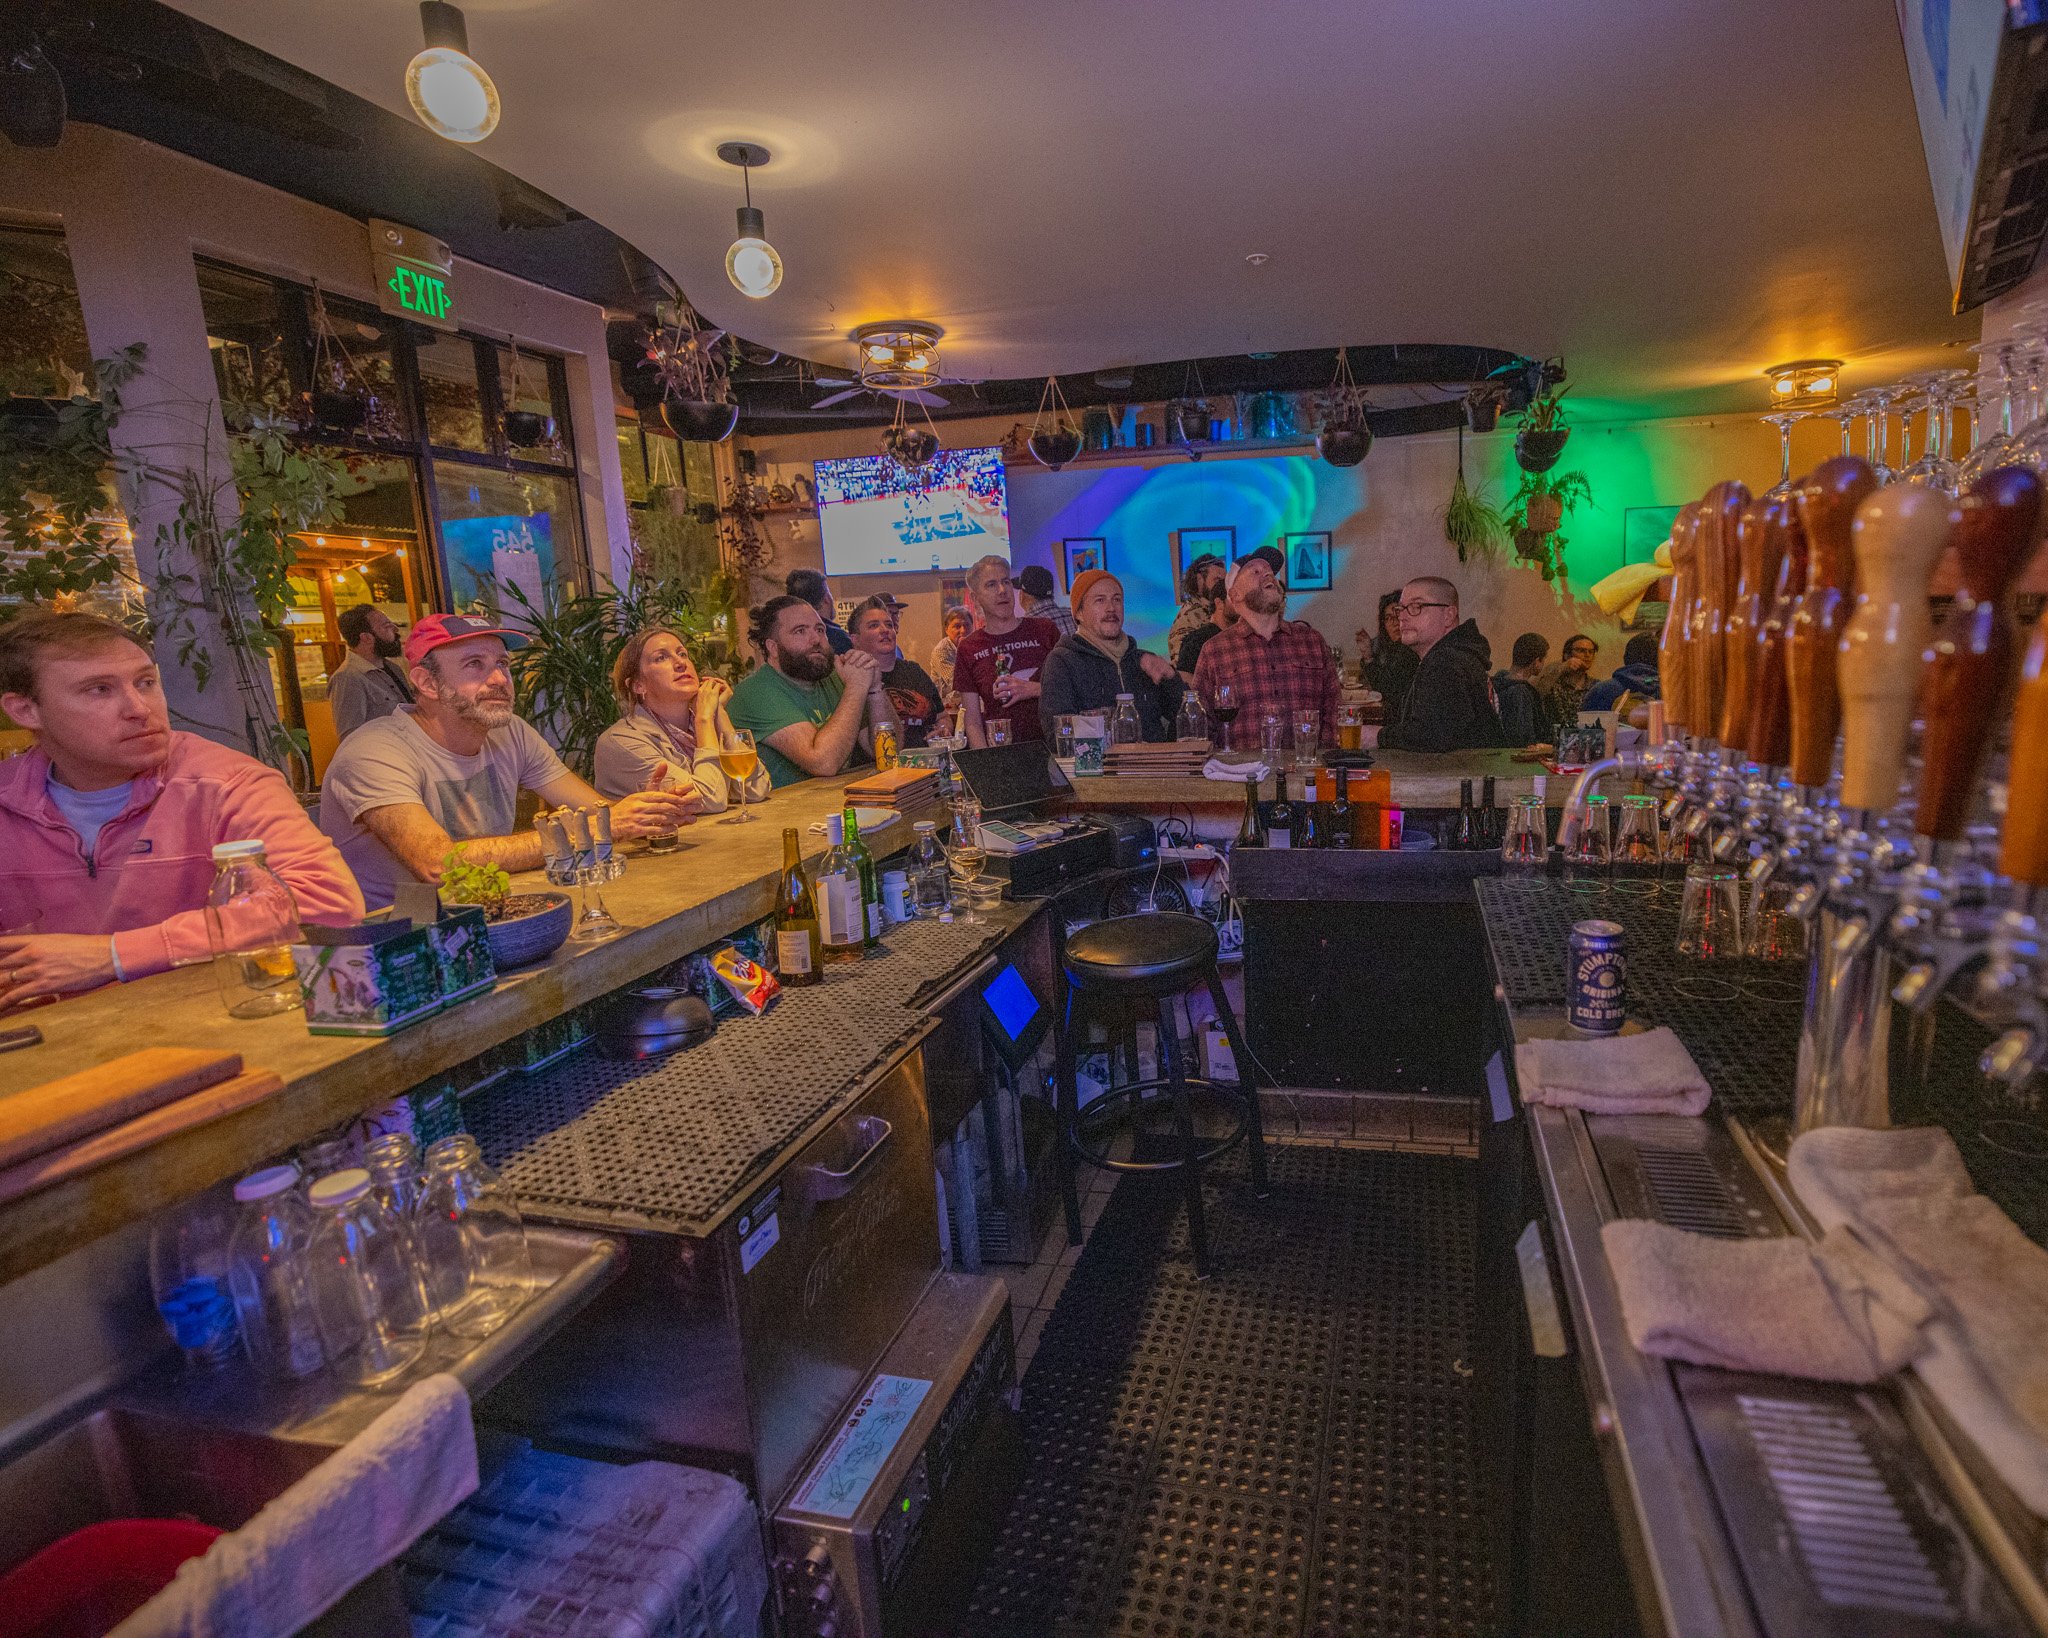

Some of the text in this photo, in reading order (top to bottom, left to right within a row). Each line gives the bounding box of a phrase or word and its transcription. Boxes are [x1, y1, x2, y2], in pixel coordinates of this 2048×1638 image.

[395, 265, 446, 320] EXIT
[974, 639, 1040, 660] THE NTIONAL
[1577, 1007, 1602, 1019] COLD
